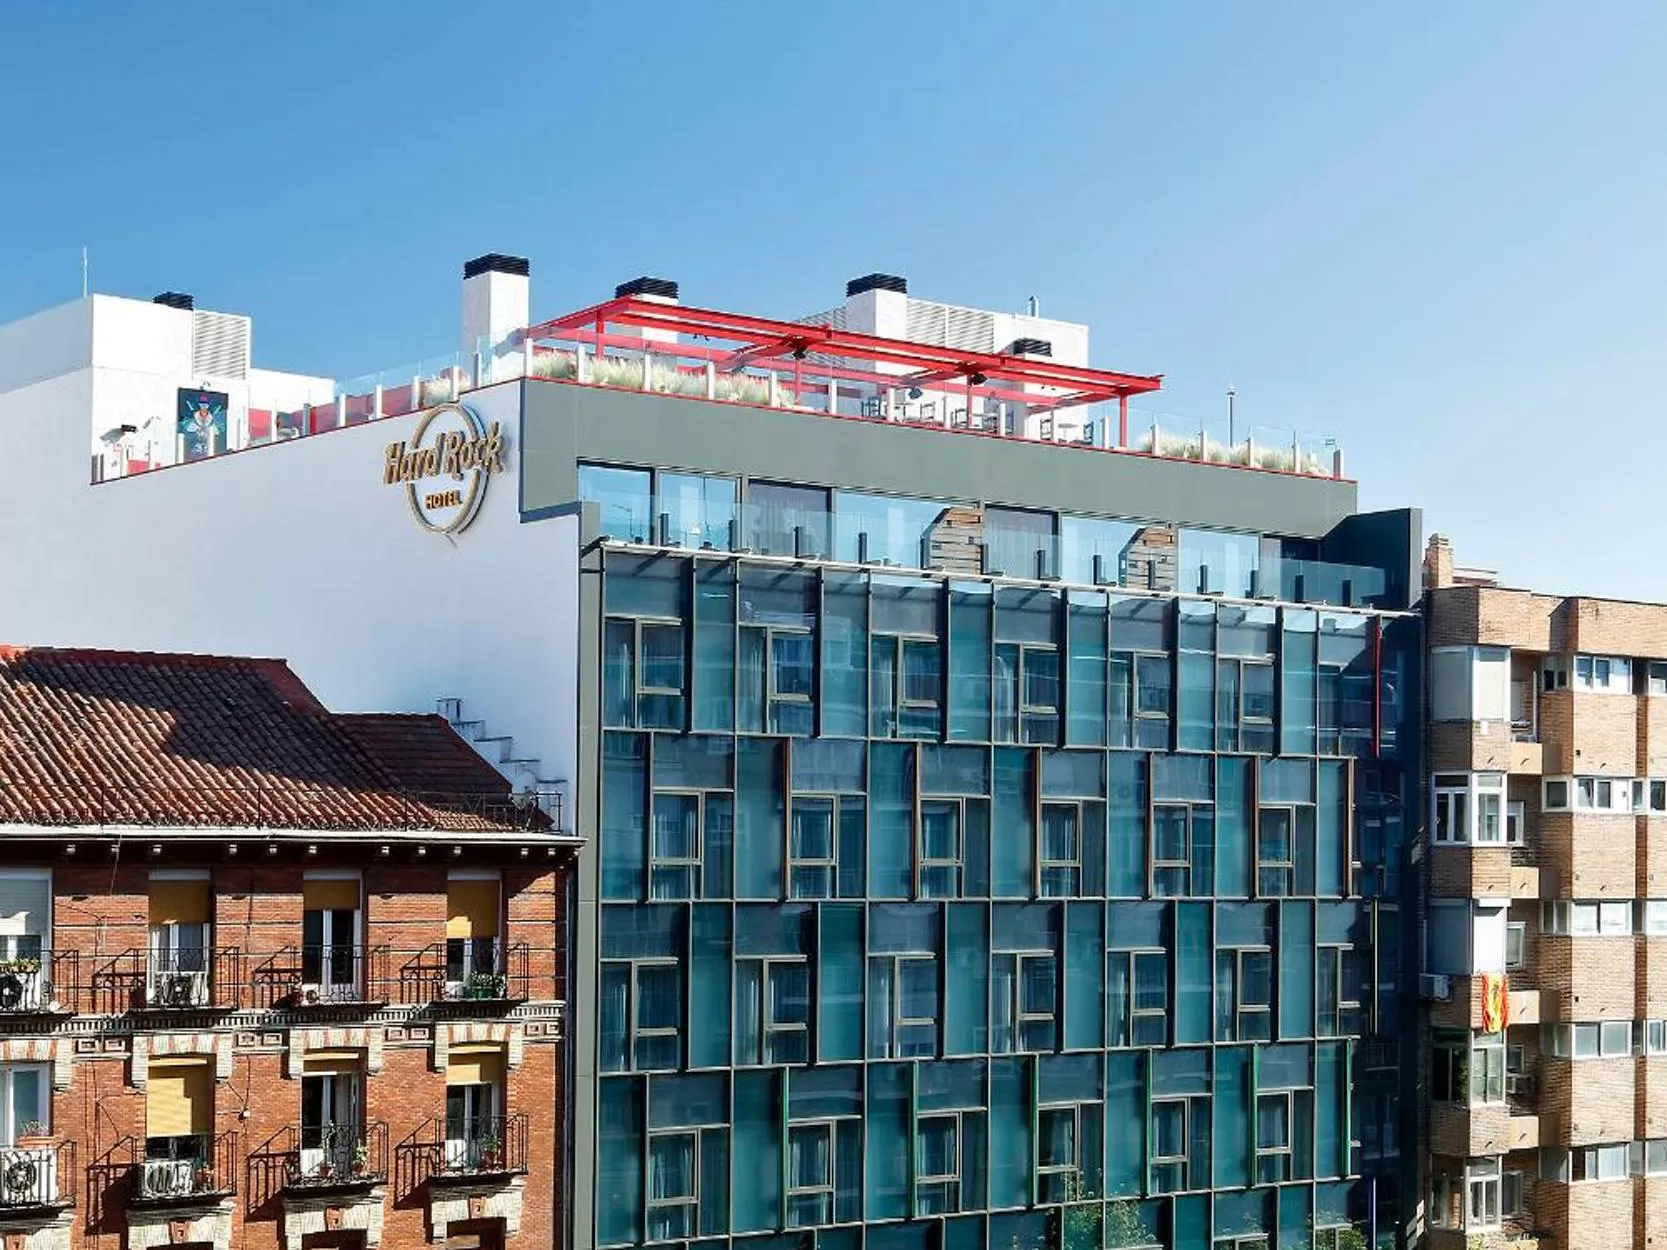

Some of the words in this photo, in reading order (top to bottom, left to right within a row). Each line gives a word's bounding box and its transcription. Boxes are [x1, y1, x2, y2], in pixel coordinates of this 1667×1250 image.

[384, 432, 446, 484] Hard
[442, 421, 504, 481] Rock
[425, 490, 462, 510] HOTEL
